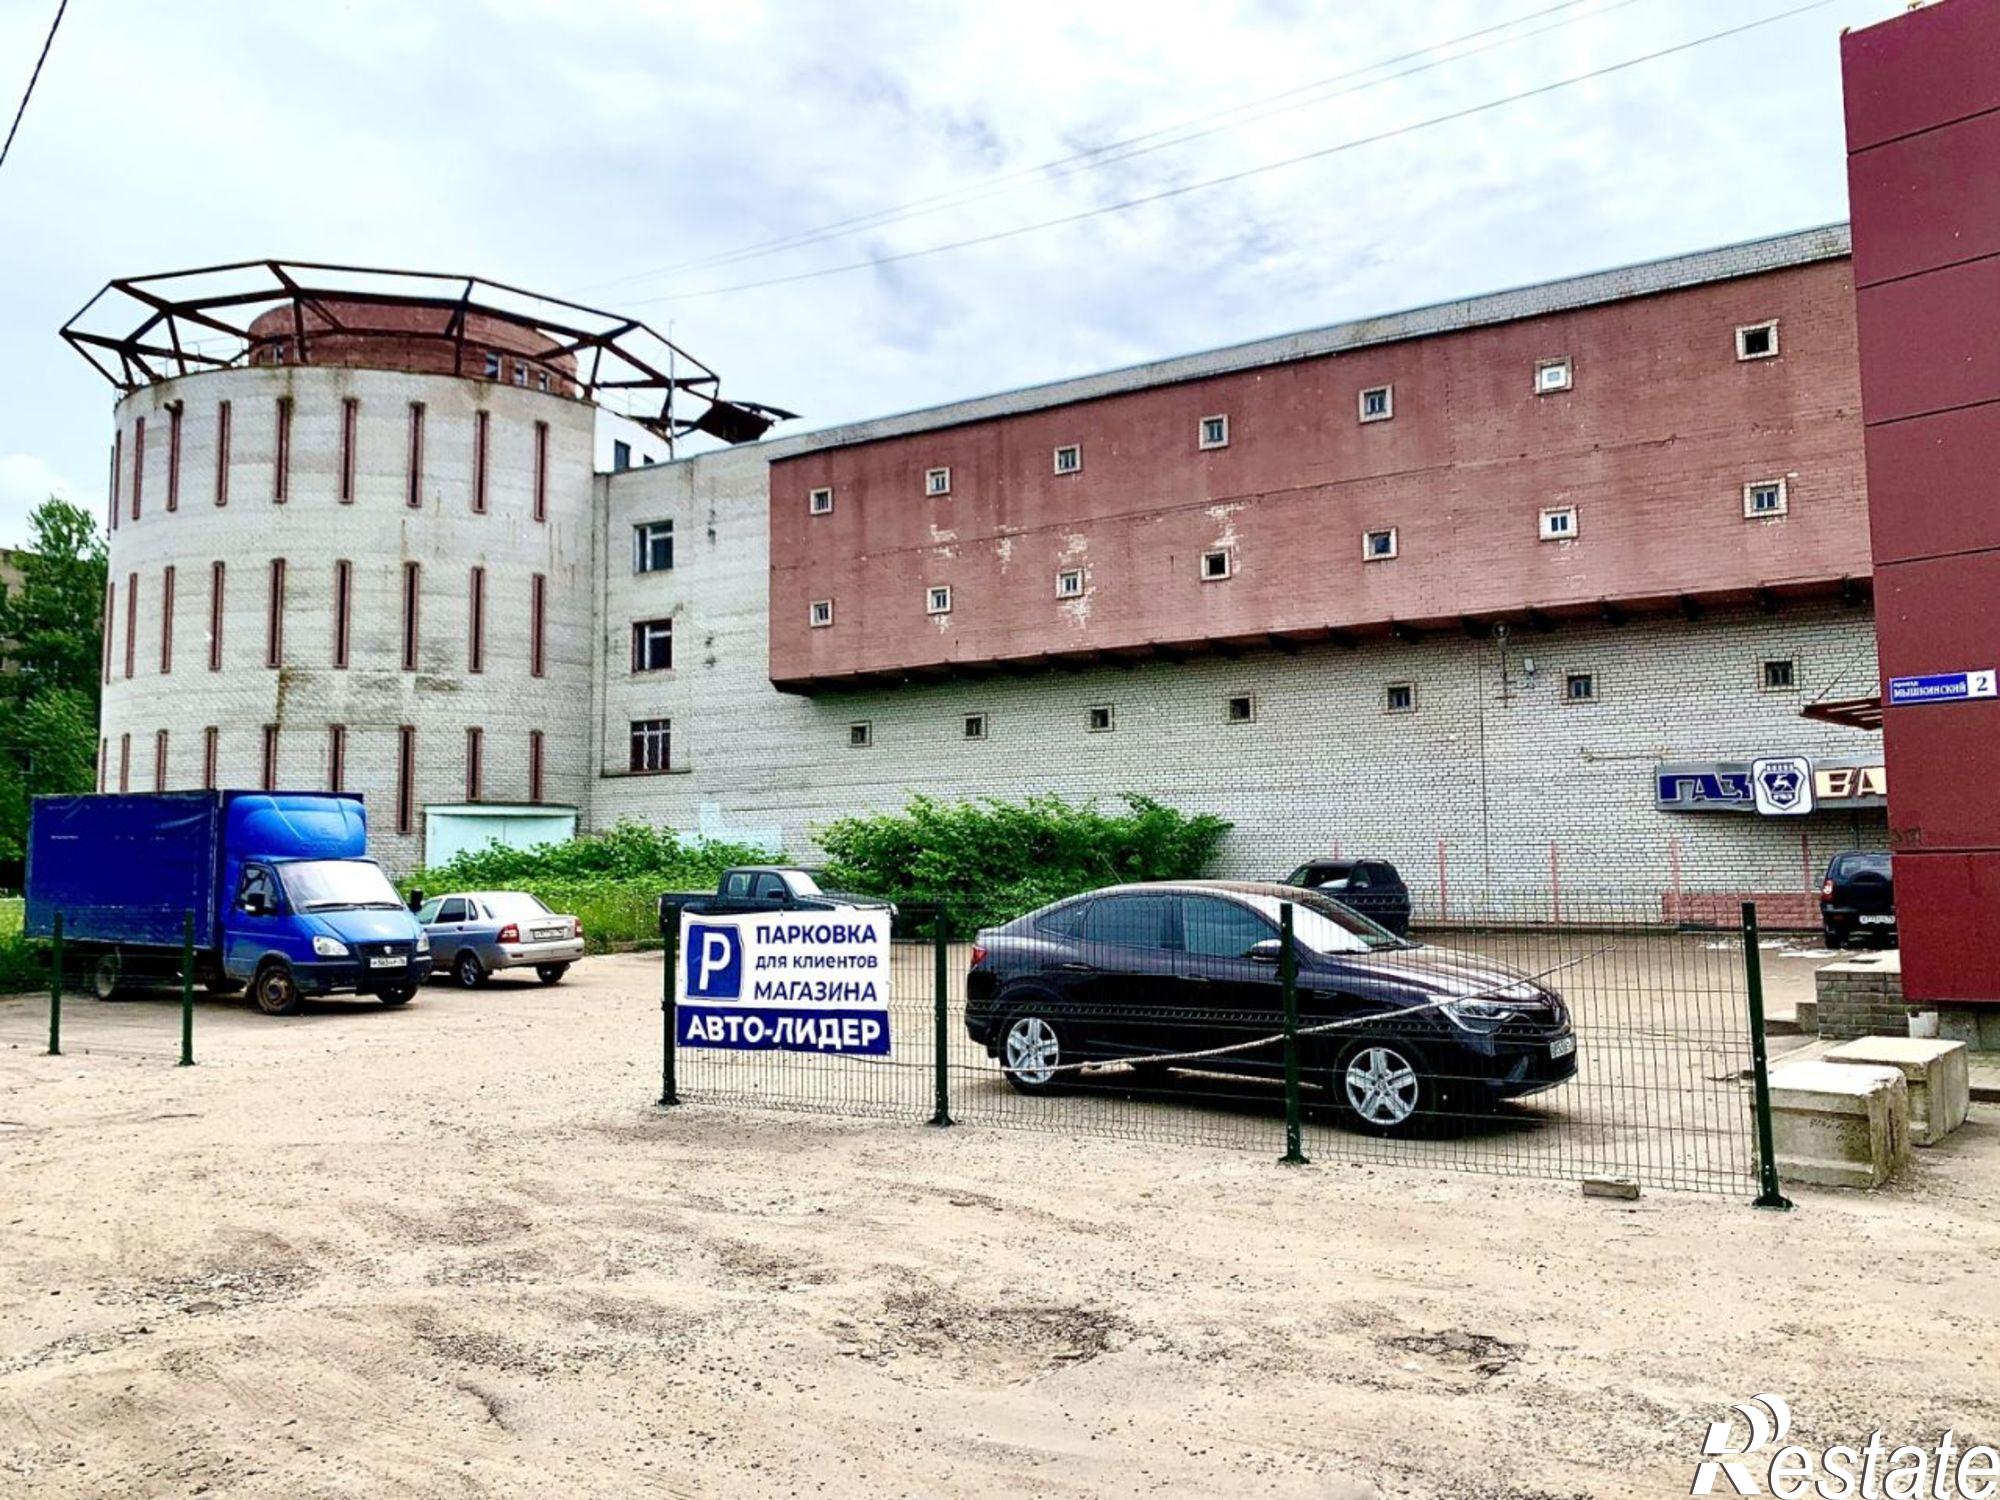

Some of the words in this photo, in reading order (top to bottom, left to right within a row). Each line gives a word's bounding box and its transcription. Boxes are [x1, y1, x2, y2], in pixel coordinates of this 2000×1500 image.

[1893, 681, 1966, 698] МЫШКИНСКИЙ
[1976, 676, 1988, 691] 2
[1658, 772, 1753, 801] ГАЗ
[756, 924, 877, 944] ПАРКОВКА
[755, 955, 787, 971] для
[793, 955, 878, 969] клиентов
[754, 981, 877, 1002] МАГАЗИНА
[686, 1014, 881, 1050] АВТО-ЛИДЕР
